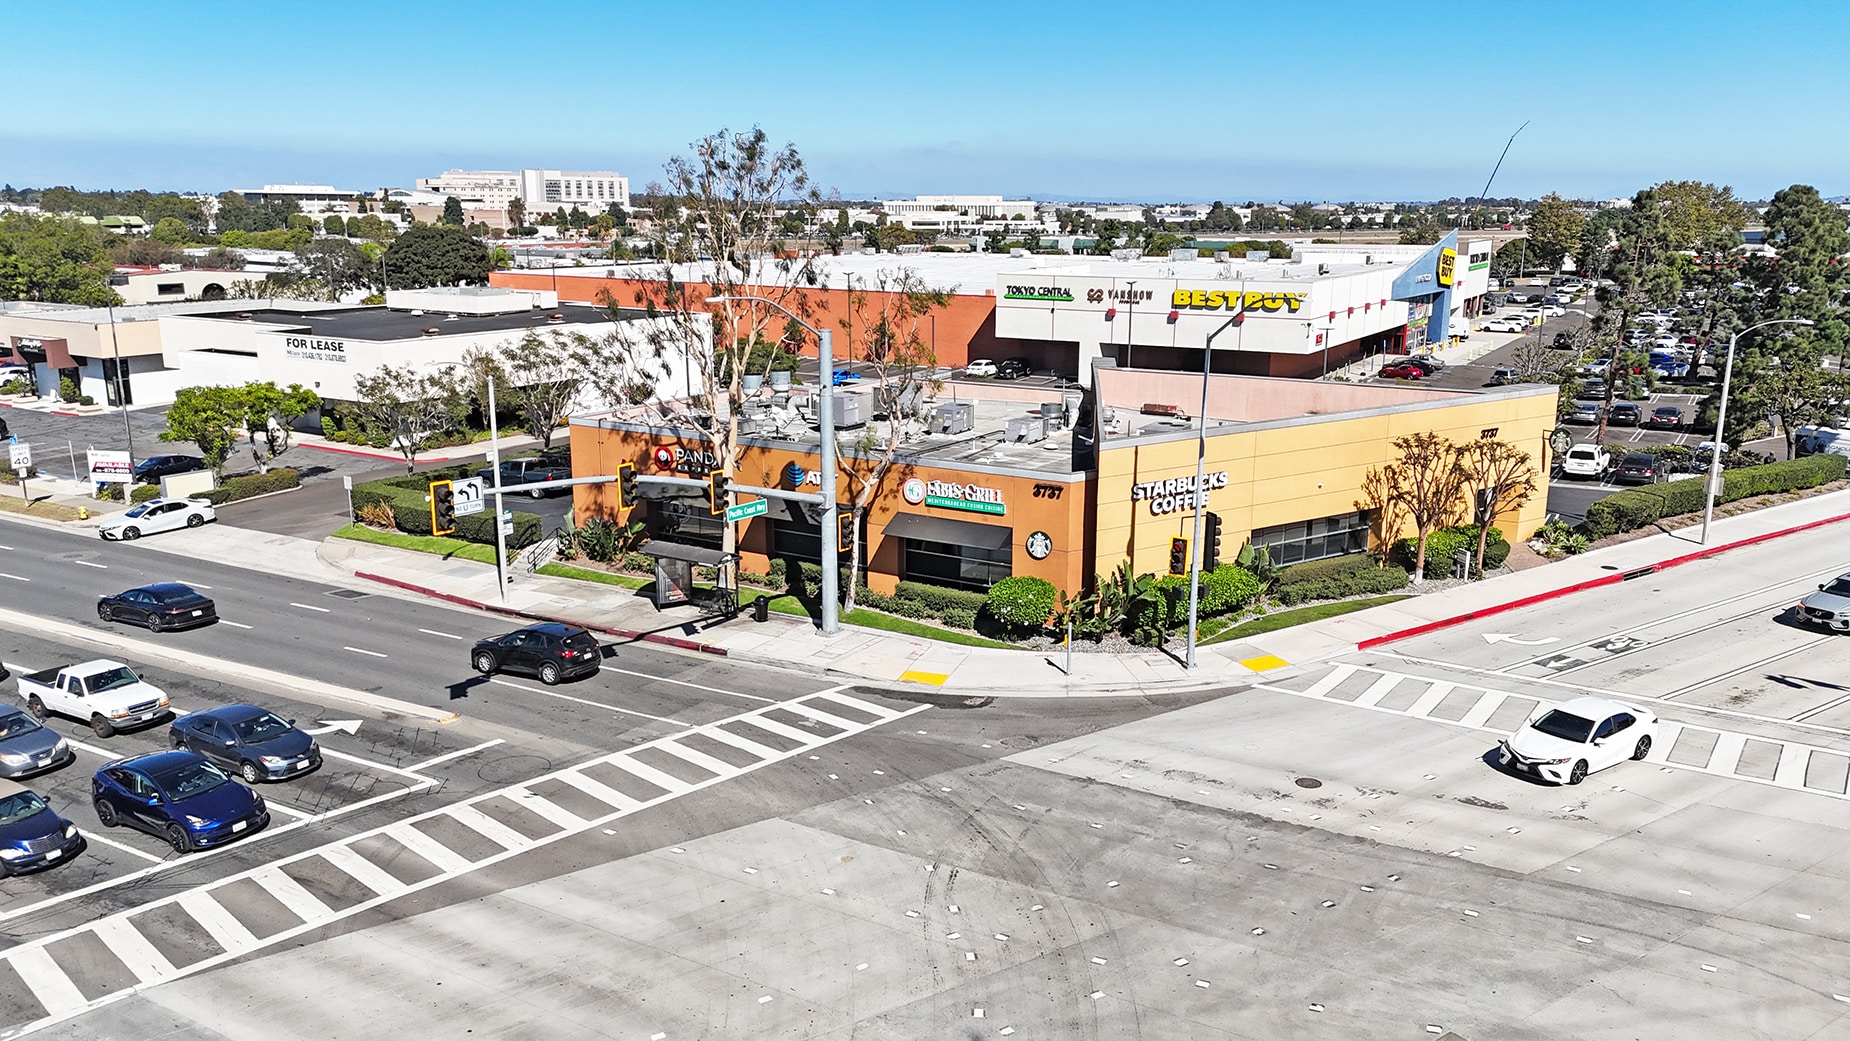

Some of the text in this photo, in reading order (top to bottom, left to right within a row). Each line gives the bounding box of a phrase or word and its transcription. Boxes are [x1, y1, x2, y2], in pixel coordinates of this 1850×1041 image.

[1442, 254, 1455, 267] BEST
[1441, 266, 1453, 278] BUY
[1006, 285, 1036, 295] TOKYO
[1037, 286, 1072, 297] CENTRAL
[1172, 289, 1307, 312] BEST BUY
[286, 338, 345, 352] FOR LEASE
[1480, 427, 1499, 440] 3737
[14, 456, 29, 465] 40
[676, 449, 718, 467] PAND
[1032, 483, 1064, 500] 3737
[1133, 471, 1229, 499] STARBUCKS
[961, 484, 1004, 504] GRILL
[729, 503, 765, 518] Pacific Coast Hwy
